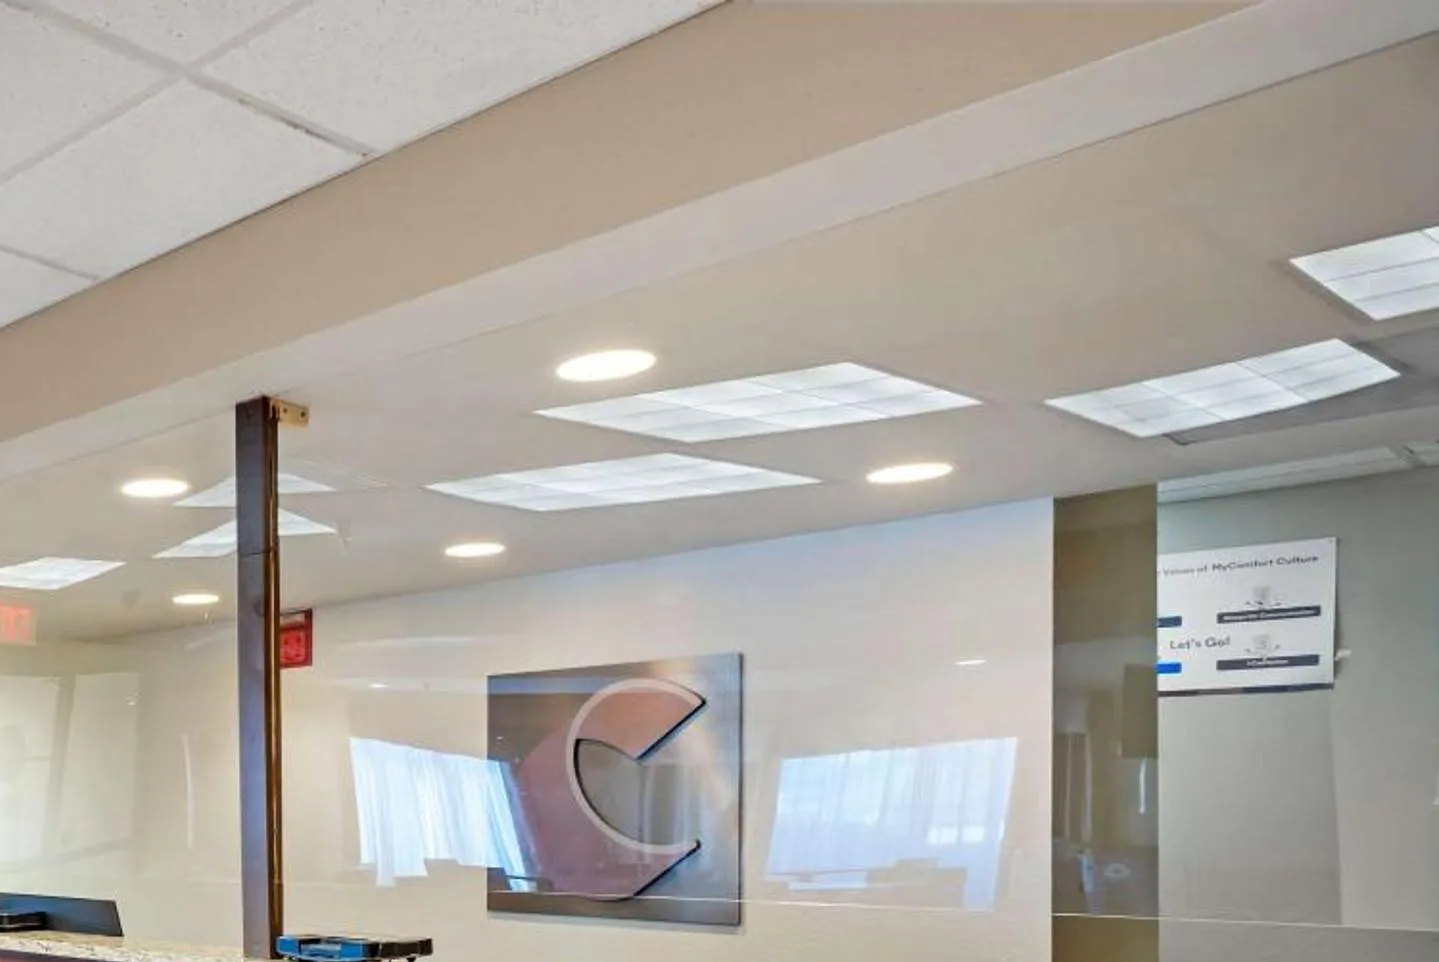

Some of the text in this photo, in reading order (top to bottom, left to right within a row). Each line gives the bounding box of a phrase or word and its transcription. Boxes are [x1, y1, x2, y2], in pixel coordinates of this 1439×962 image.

[1276, 555, 1319, 566] Culture
[1170, 635, 1231, 650] Let's Go!
